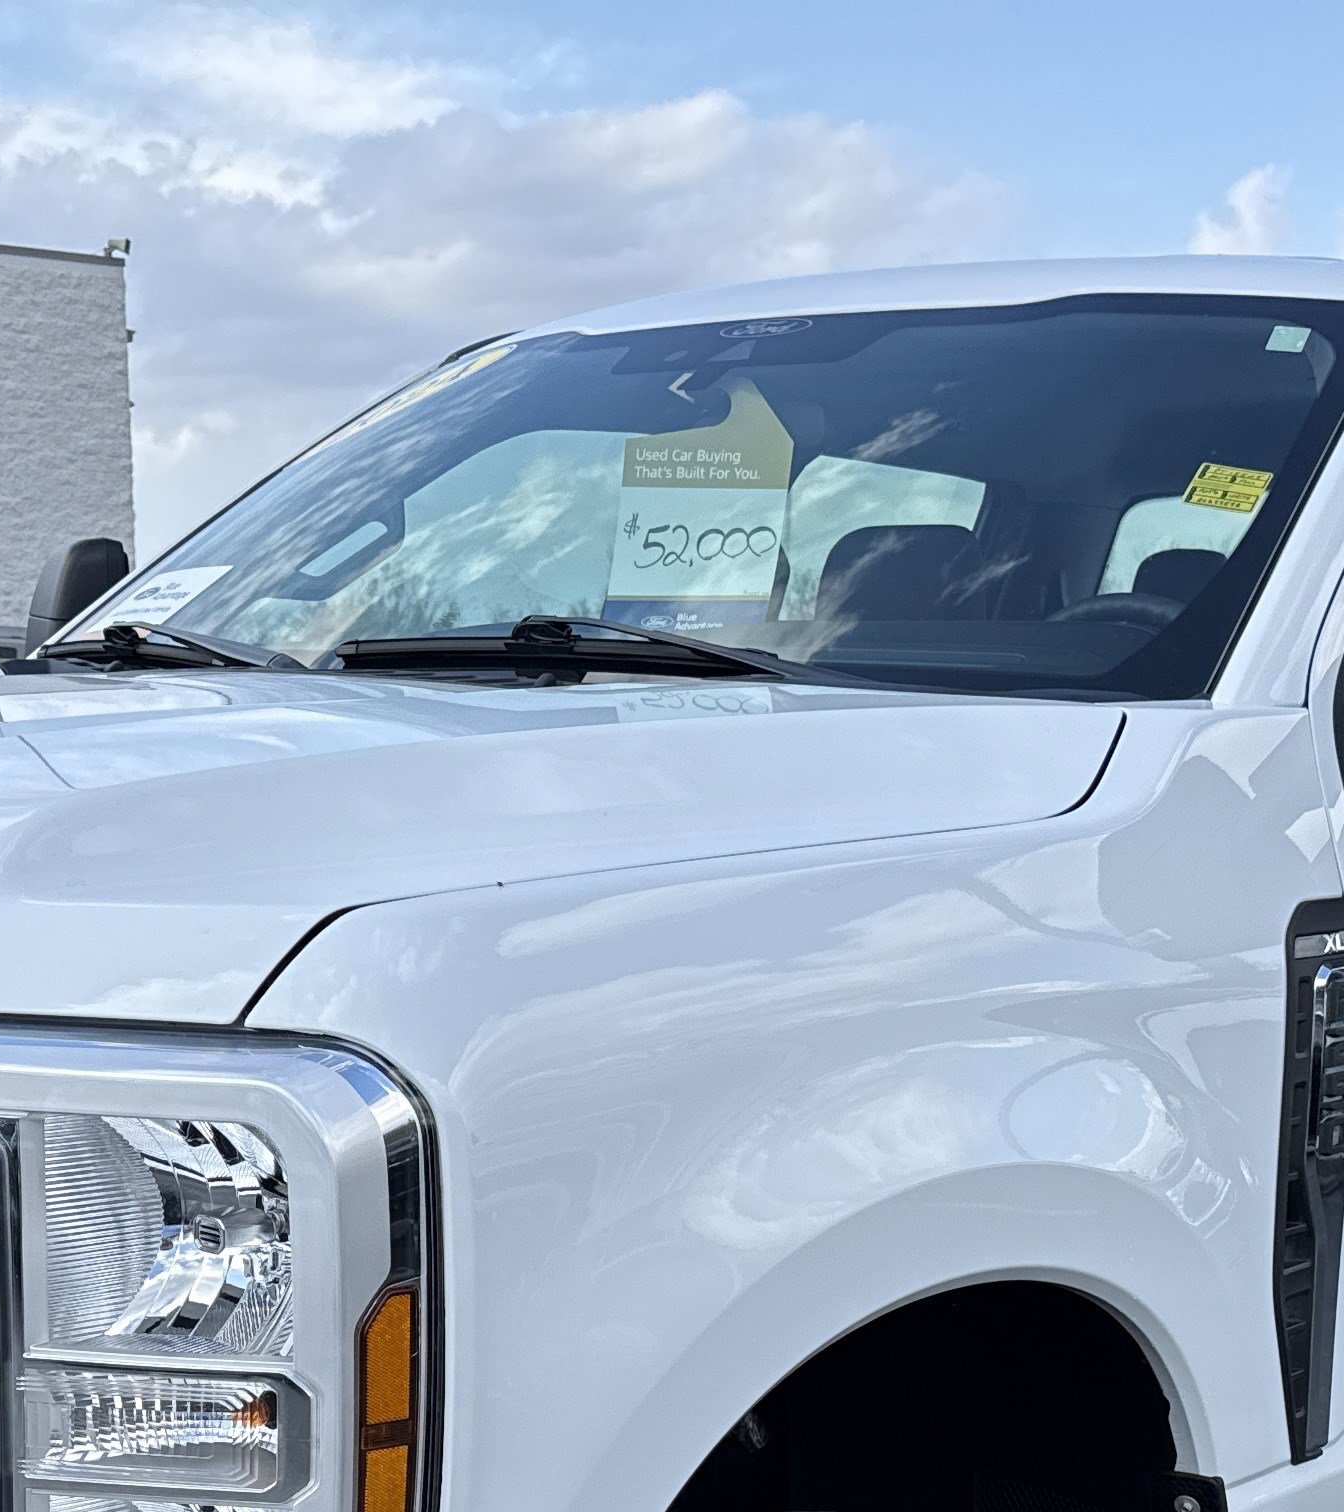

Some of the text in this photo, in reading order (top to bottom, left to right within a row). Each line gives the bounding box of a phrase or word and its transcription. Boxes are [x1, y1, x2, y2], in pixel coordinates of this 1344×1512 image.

[635, 448, 741, 464] Used Car Buying
[634, 466, 760, 480] That's Built For You.
[623, 512, 777, 569] $52,000
[676, 613, 697, 622] Blue
